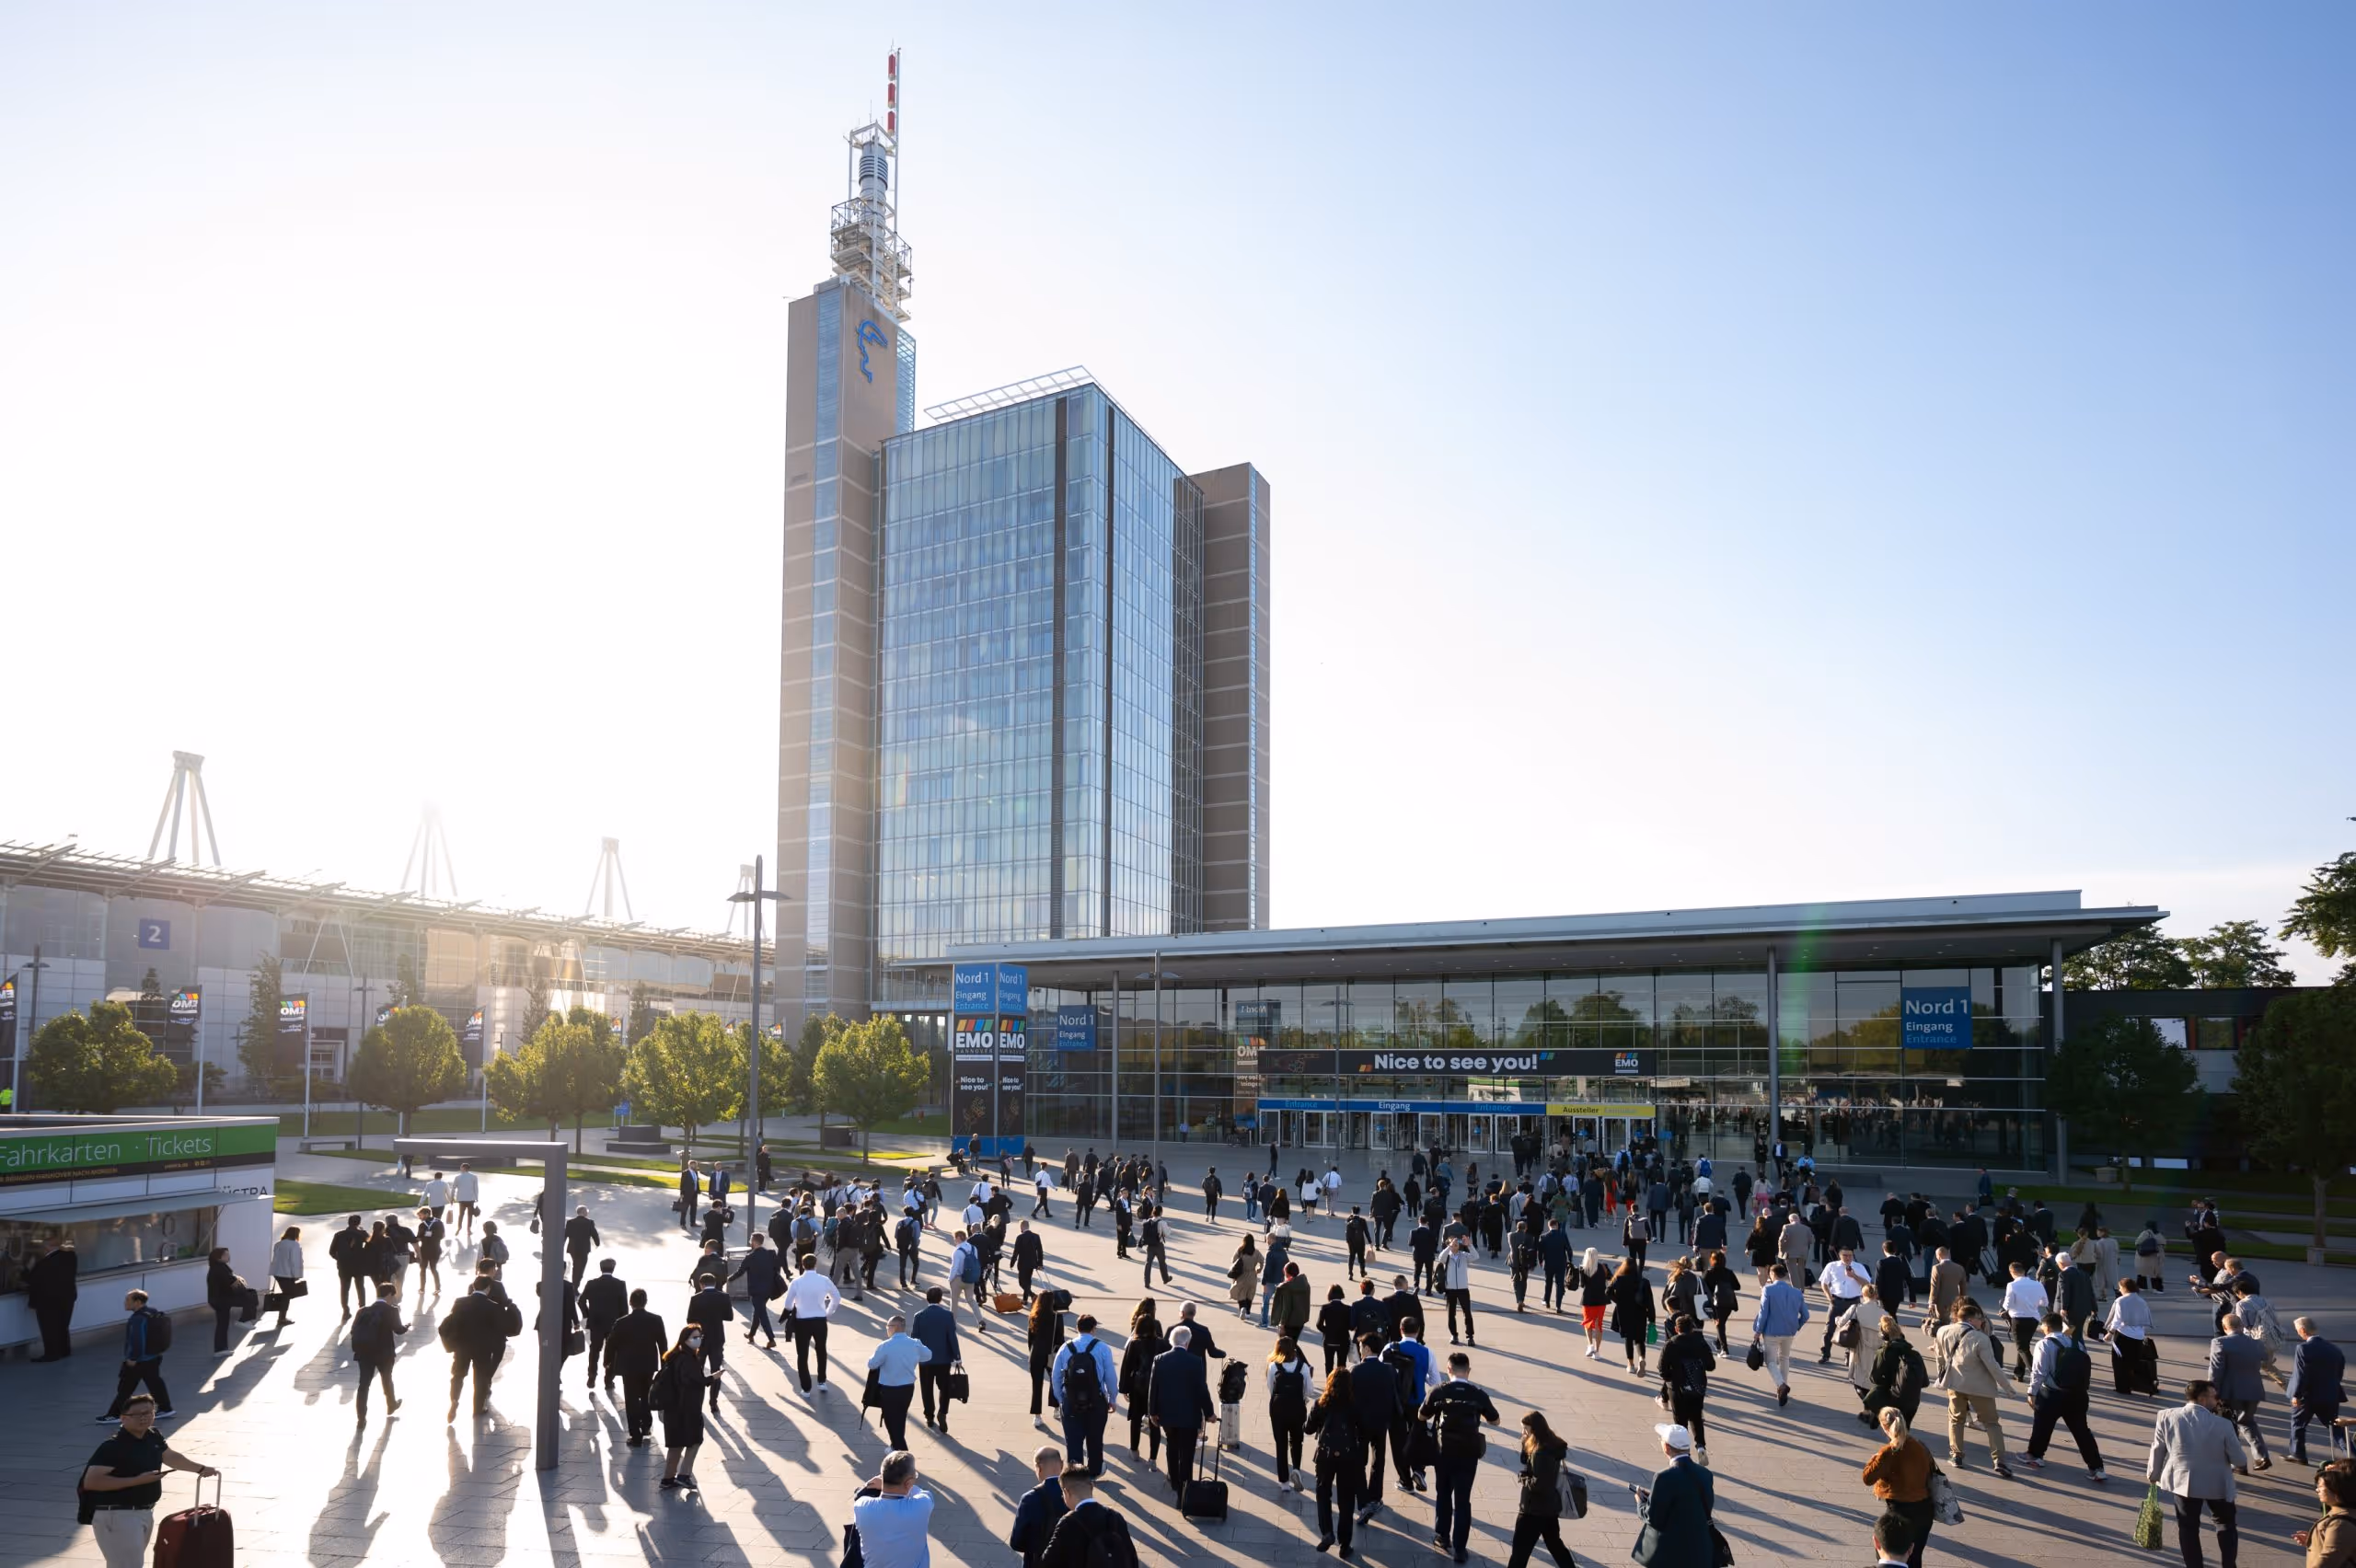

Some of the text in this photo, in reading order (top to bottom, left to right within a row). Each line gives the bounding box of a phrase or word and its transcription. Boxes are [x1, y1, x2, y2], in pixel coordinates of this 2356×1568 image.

[148, 926, 162, 942] 2
[956, 972, 988, 984] Nord 1
[999, 972, 1018, 985] Nord
[955, 991, 987, 1001] Eingang
[999, 990, 1022, 1002] Eingang
[955, 1001, 988, 1010] Entrance
[1905, 998, 1968, 1014] Nord 1
[1059, 1014, 1086, 1025] Nord
[1090, 1015, 1094, 1025] 1
[1906, 1021, 1953, 1033] Eingang
[955, 1032, 994, 1048] EMO
[999, 1032, 1025, 1049] EMO
[1059, 1031, 1086, 1040] Eingang
[1907, 1034, 1957, 1043] Entrance
[1374, 1054, 1538, 1073] Nice to see you!
[1614, 1058, 1638, 1067] EMO
[1378, 1101, 1410, 1112] Eingang
[145, 1135, 212, 1157] Tickets
